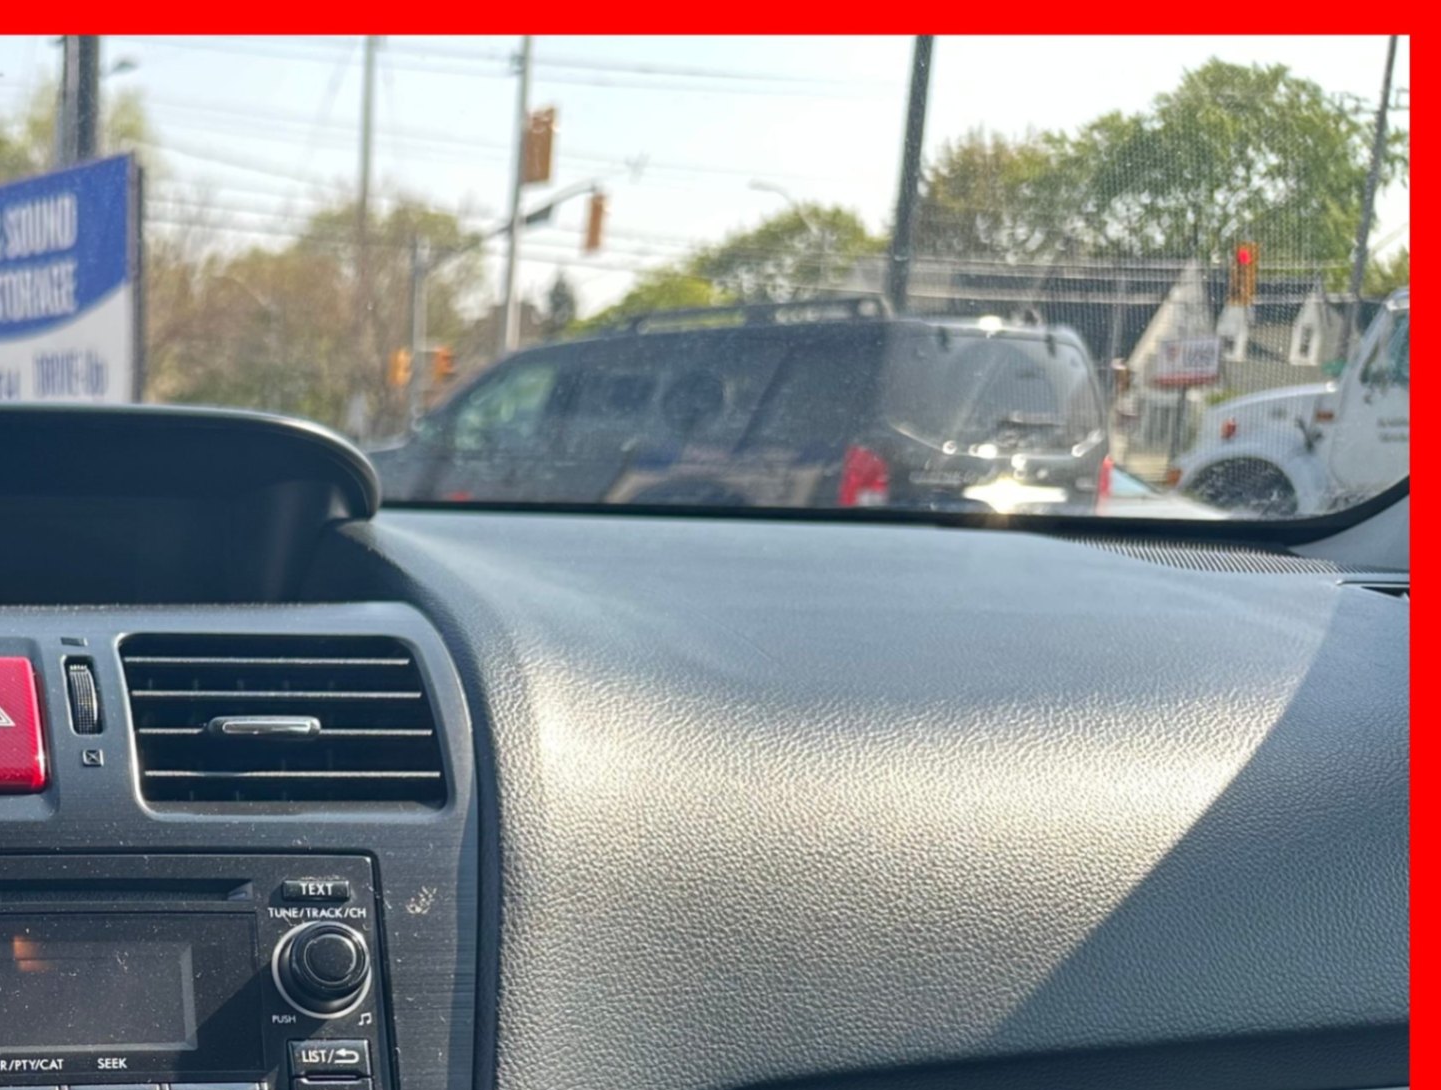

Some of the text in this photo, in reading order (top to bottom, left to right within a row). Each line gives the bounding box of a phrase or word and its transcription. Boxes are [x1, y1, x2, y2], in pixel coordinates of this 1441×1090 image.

[298, 882, 335, 895] TEXT
[267, 905, 367, 919] TUNE/TRACK/CH
[272, 1015, 296, 1023] PUSH
[97, 1058, 127, 1069] SEEK
